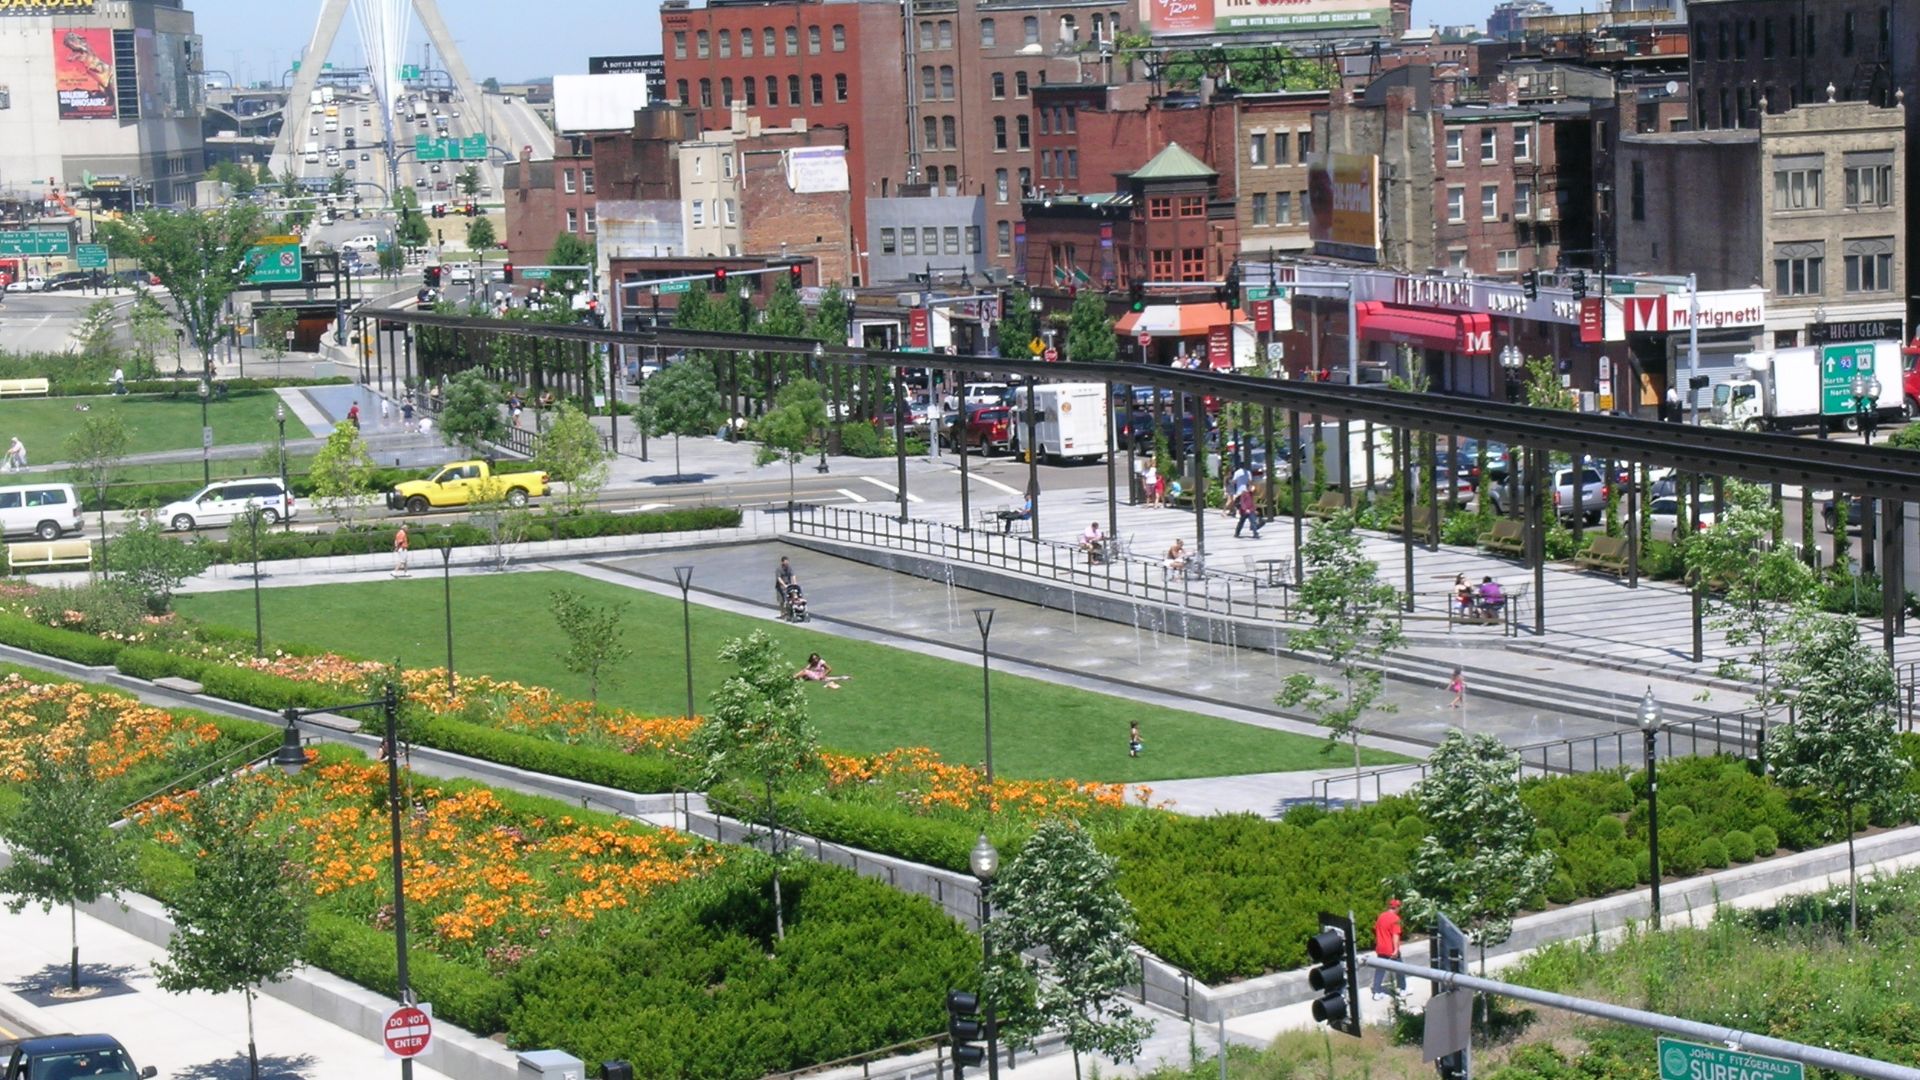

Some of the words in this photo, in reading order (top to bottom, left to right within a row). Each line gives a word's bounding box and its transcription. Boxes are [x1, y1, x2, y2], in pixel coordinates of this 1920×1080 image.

[1830, 323, 1856, 339] HIGH
[1858, 322, 1885, 337] GEAR
[1466, 331, 1492, 352] M
[1840, 357, 1853, 368] 93
[390, 1017, 403, 1027] DO
[407, 1014, 425, 1025] NOT
[394, 1037, 423, 1049] ENTER
[1689, 1048, 1715, 1061] JOHN
[1719, 1054, 1726, 1062] F
[1729, 1055, 1790, 1075] FITZGERALD
